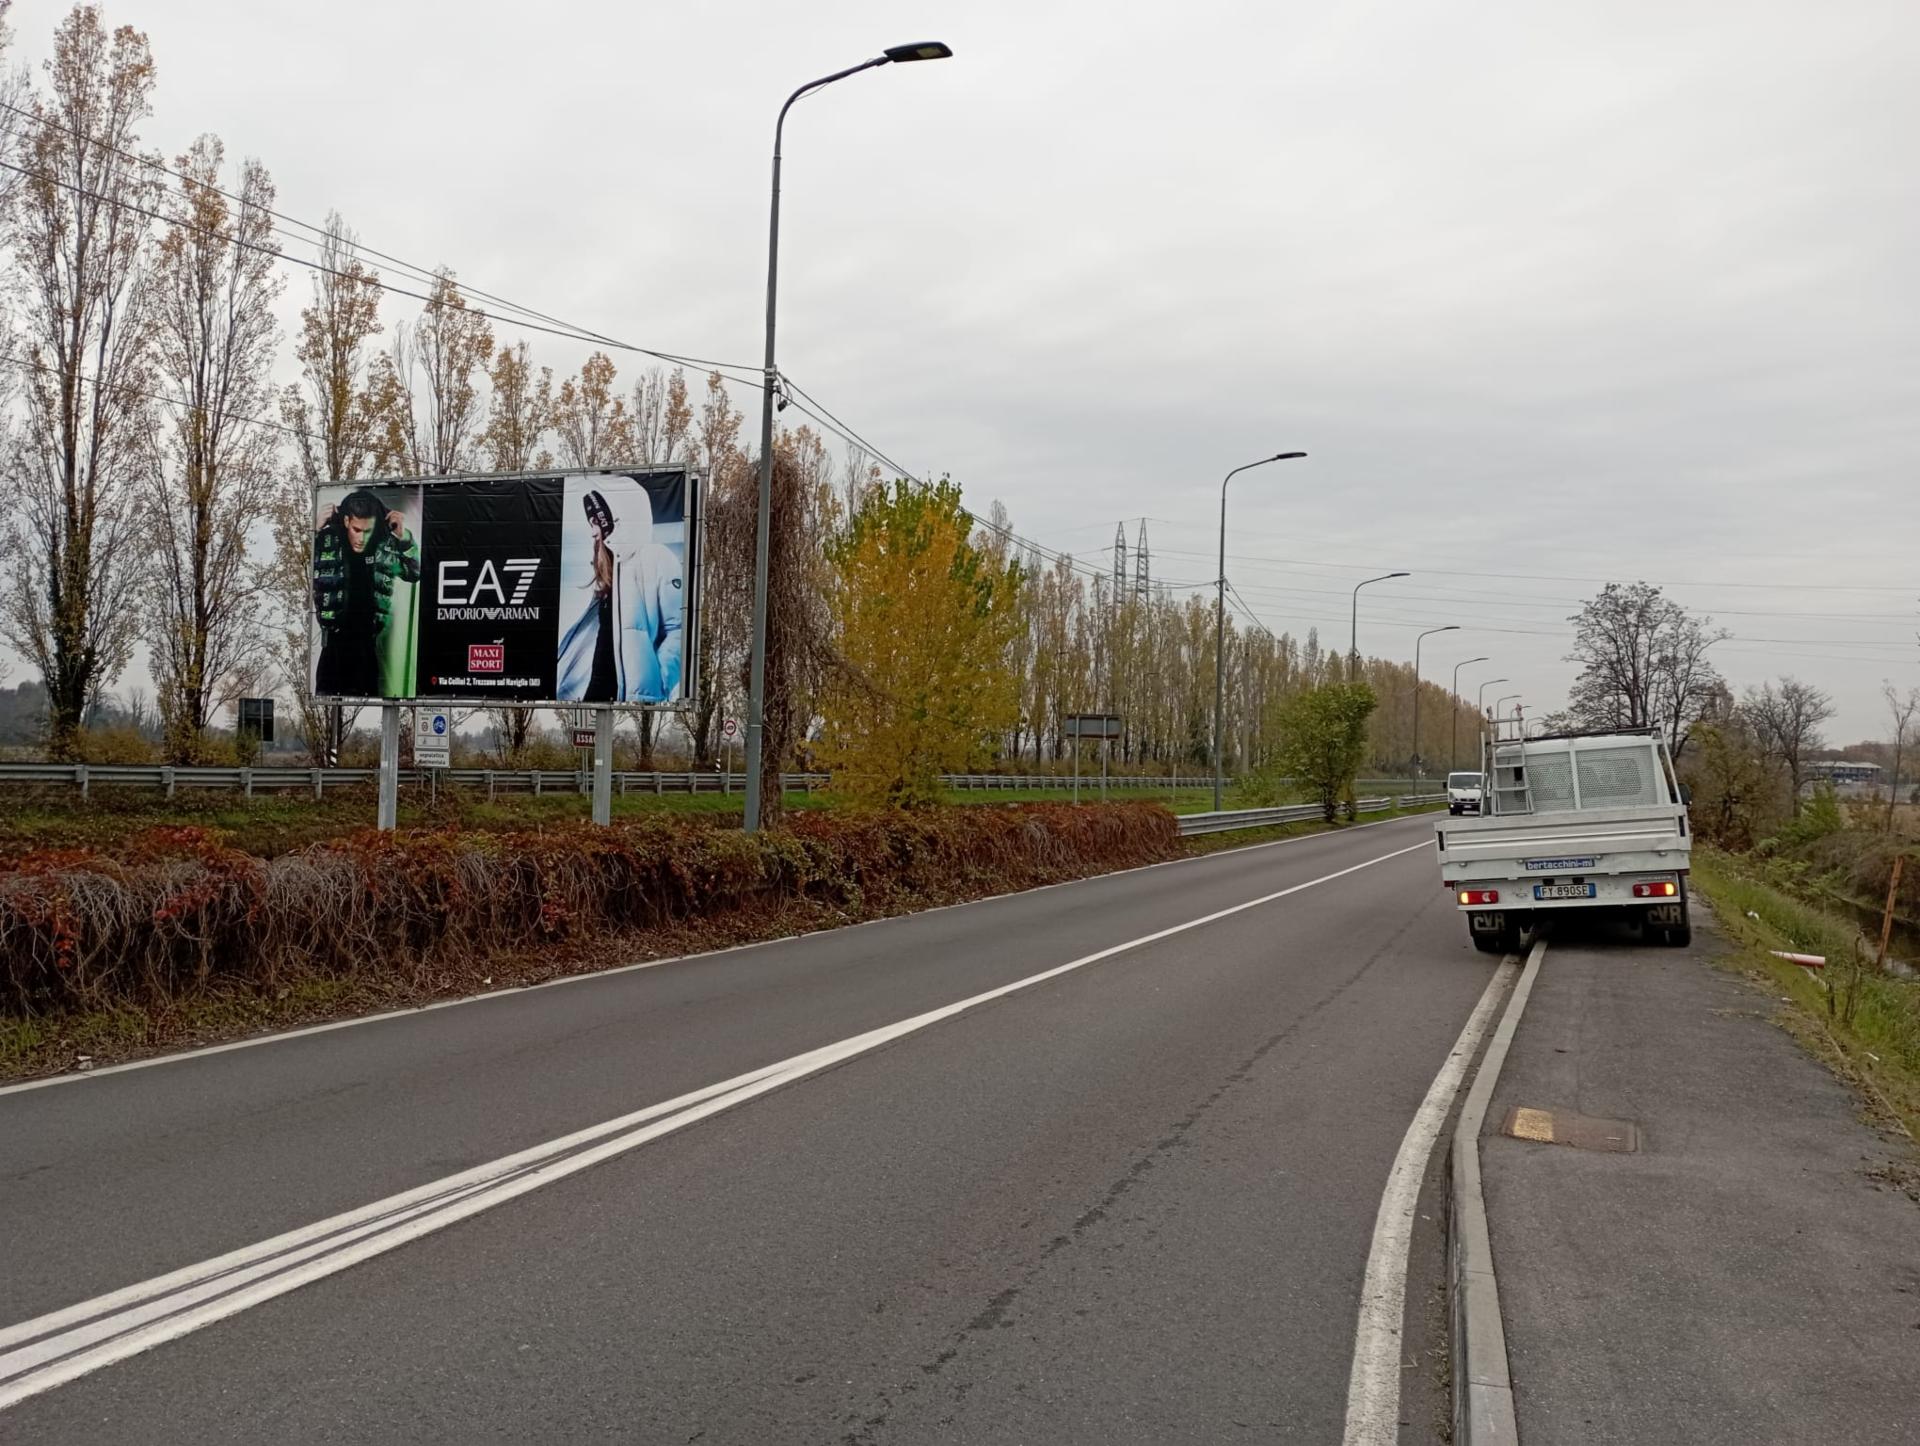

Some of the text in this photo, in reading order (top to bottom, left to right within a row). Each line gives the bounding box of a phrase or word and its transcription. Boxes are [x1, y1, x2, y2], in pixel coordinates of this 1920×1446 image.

[438, 558, 541, 605] EA7
[437, 607, 540, 620] EMPORIO ARMANI
[473, 648, 499, 658] MAXI
[470, 659, 501, 669] SPORT
[438, 677, 447, 686] Via
[576, 734, 596, 744] ASSA
[1541, 887, 1552, 897] FY
